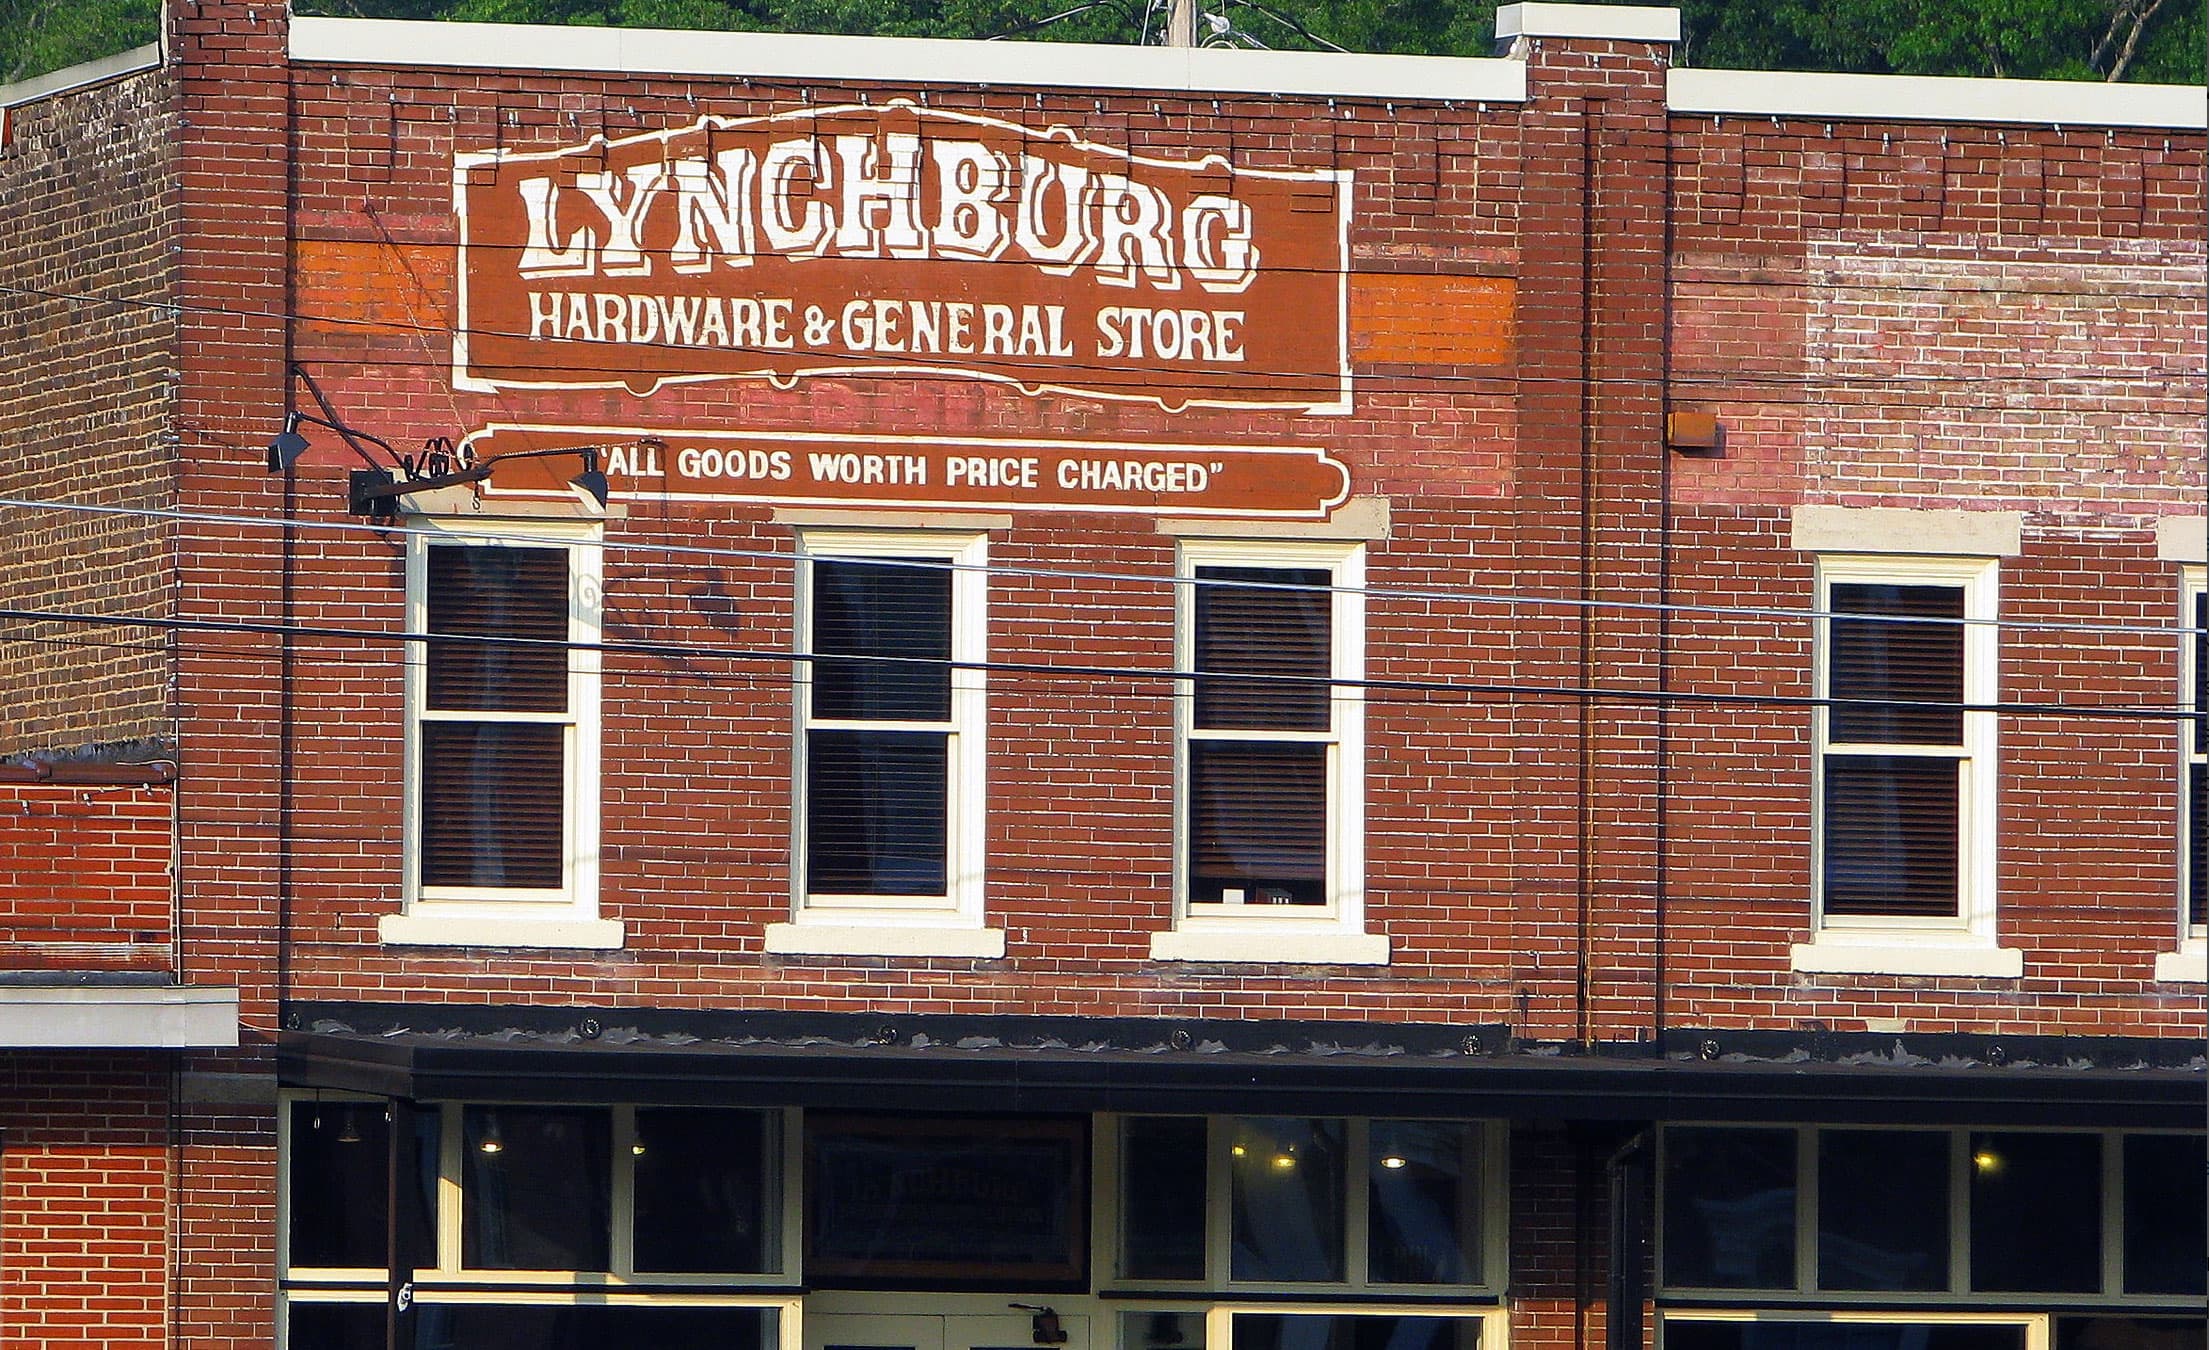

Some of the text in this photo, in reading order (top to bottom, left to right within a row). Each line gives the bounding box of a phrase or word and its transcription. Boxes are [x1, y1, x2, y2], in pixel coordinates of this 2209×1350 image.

[518, 132, 1259, 294] LYNCHBURG
[528, 292, 1245, 362] HARDWARE & GENERAL STORE
[677, 448, 792, 480] GOODS
[808, 453, 927, 485] WORTH
[946, 457, 1039, 488] PRICE
[1057, 459, 1224, 492] CHARGED"
